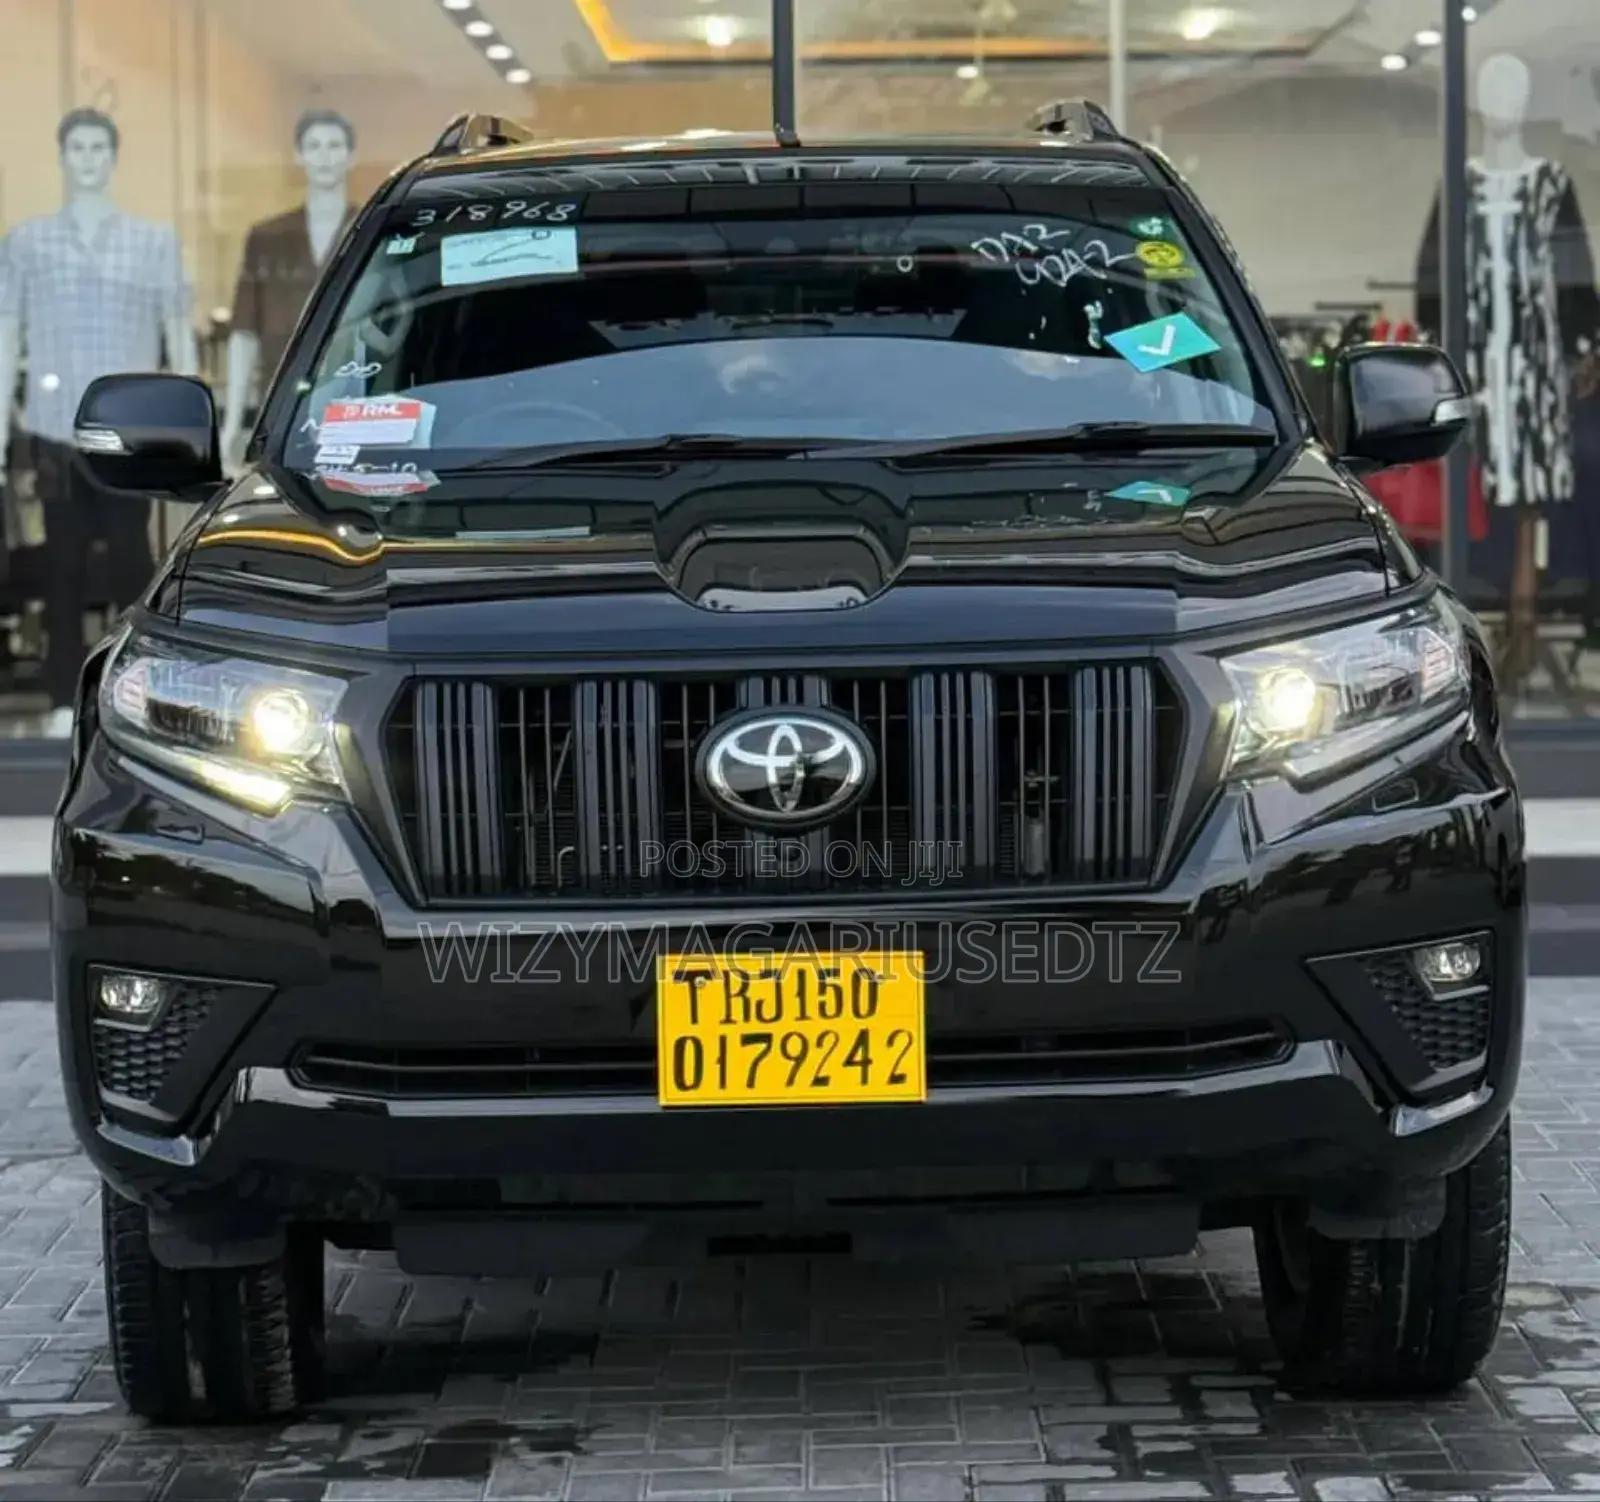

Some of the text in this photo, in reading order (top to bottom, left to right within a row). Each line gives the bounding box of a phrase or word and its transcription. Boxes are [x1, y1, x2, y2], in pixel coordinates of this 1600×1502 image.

[411, 200, 576, 227] 318968
[673, 968, 880, 1026] TRJ150
[673, 1028, 914, 1092] 0179242
